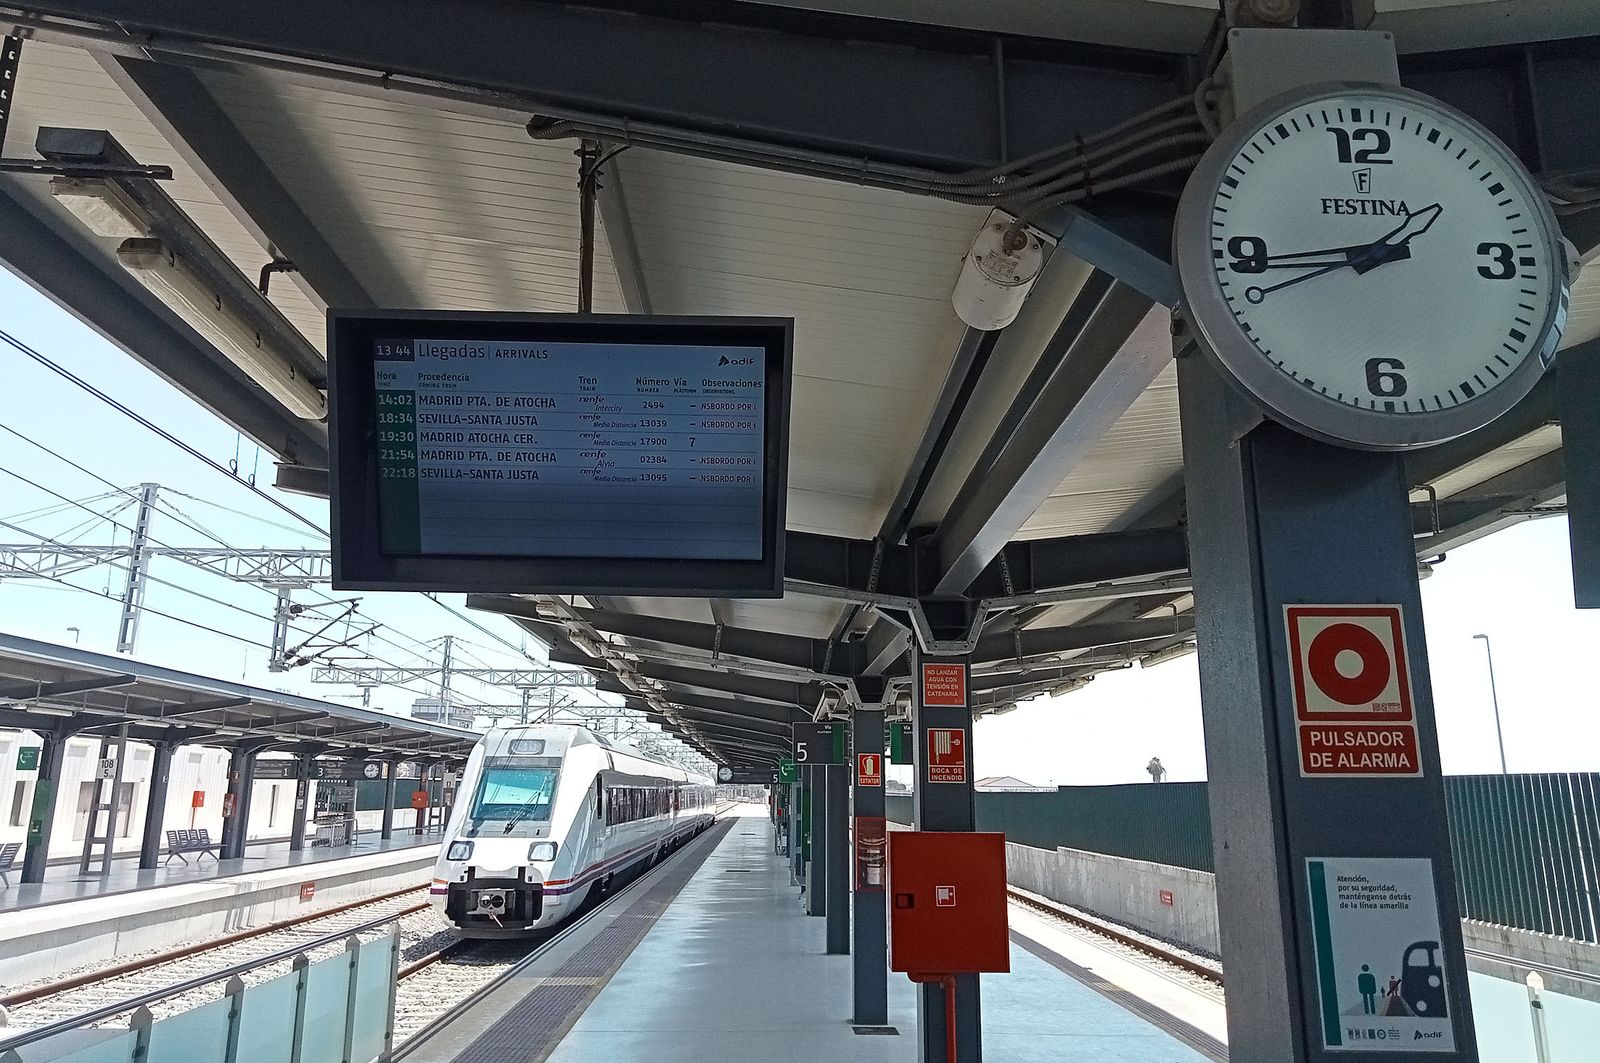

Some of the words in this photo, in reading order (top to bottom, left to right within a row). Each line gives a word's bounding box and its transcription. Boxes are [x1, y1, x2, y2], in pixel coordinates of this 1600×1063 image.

[1326, 127, 1393, 164] 12
[1357, 173, 1369, 191] F
[1320, 198, 1411, 216] FESTINA
[1227, 236, 1268, 274] 9
[1476, 242, 1516, 280] 3
[377, 346, 391, 356] 13
[396, 346, 411, 356] 44
[419, 344, 485, 360] Llegadas
[495, 349, 548, 359] ARRIVALS
[730, 357, 755, 366] adif
[376, 371, 397, 380] Hora
[418, 372, 470, 382] Procedencia
[578, 376, 597, 384] Tren
[1364, 357, 1408, 397] 6
[636, 377, 670, 386] Número
[674, 377, 687, 386] Vía
[702, 378, 762, 388] Observaciones
[378, 394, 413, 406] 14:02
[419, 396, 463, 406] MADRID
[467, 396, 491, 406] PTA.
[496, 396, 510, 406] DE
[514, 397, 556, 408] ATOCHA
[579, 396, 605, 407] renfe
[595, 404, 622, 414] Intercity
[379, 414, 414, 424] 18:34
[506, 416, 538, 426] JUSTA
[579, 414, 601, 424] renfe
[640, 420, 668, 428] 13039
[380, 432, 415, 442] 19:30
[420, 432, 464, 442] MADRID
[468, 433, 510, 444] ATOCHA
[514, 434, 538, 444] CER.
[579, 432, 601, 442] renfe
[640, 438, 668, 446] 17900
[689, 438, 696, 448] 7
[381, 450, 415, 460] 21:54
[421, 450, 464, 460] MADRID
[469, 451, 492, 462] PTA.
[497, 452, 511, 462] DE
[515, 452, 557, 463] ATOCHA
[579, 450, 607, 460] renfe
[640, 456, 668, 464] 02384
[382, 468, 416, 478] 22:18
[507, 470, 539, 480] JUSTA
[580, 468, 602, 478] renfe
[640, 474, 668, 482] 13095
[1310, 731, 1405, 746] PULSADOR
[797, 742, 808, 762] 5
[102, 760, 114, 768] 108
[1309, 752, 1334, 768] DE
[1337, 752, 1411, 768] ALARMA
[283, 768, 288, 776] 1
[318, 768, 324, 776] 3
[772, 774, 778, 783] 5
[1337, 875, 1369, 884] Atención,
[1361, 884, 1398, 892] seguridad,
[1338, 893, 1387, 901] manténganse
[1424, 1030, 1443, 1038] adif
